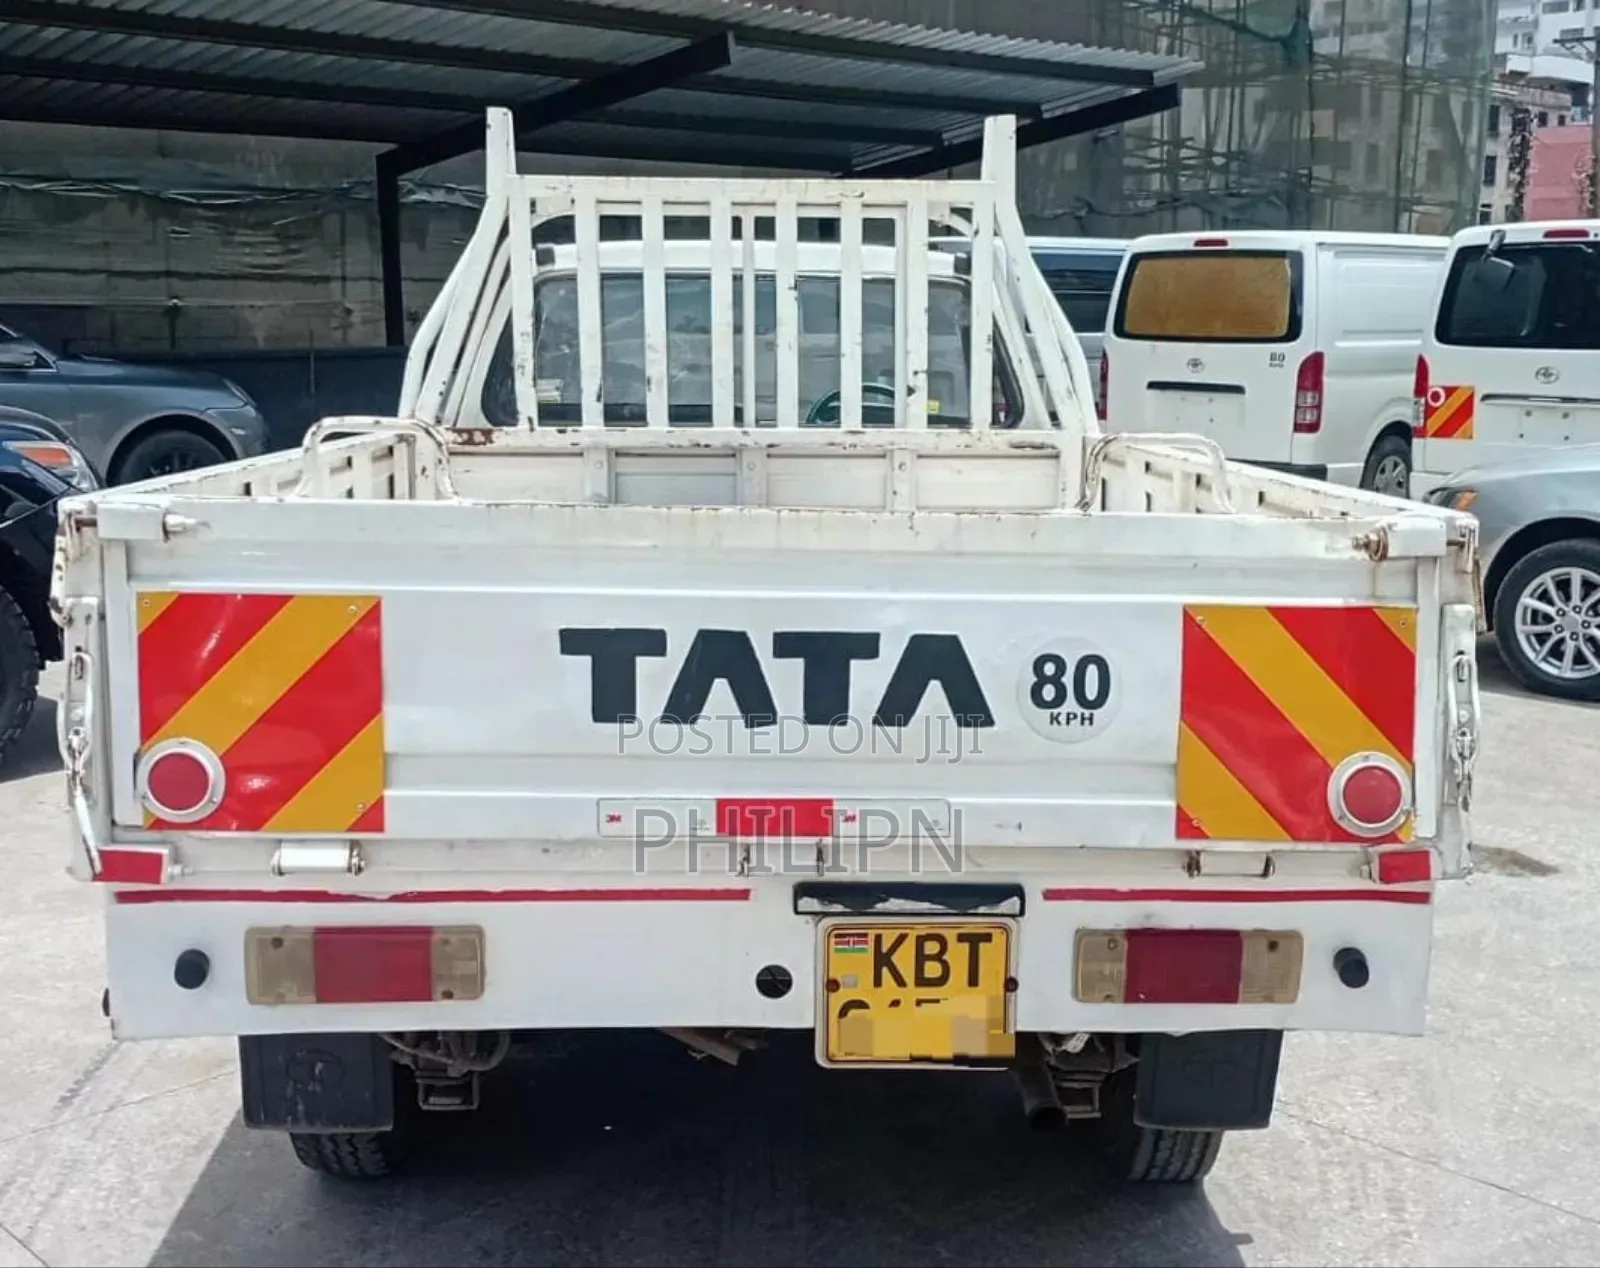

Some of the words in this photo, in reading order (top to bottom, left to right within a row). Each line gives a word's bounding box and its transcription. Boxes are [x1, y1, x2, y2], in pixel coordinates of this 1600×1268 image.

[558, 627, 995, 729] TATA
[1030, 653, 1110, 710] 80
[1049, 711, 1094, 726] KPH
[873, 932, 993, 988] KBT
